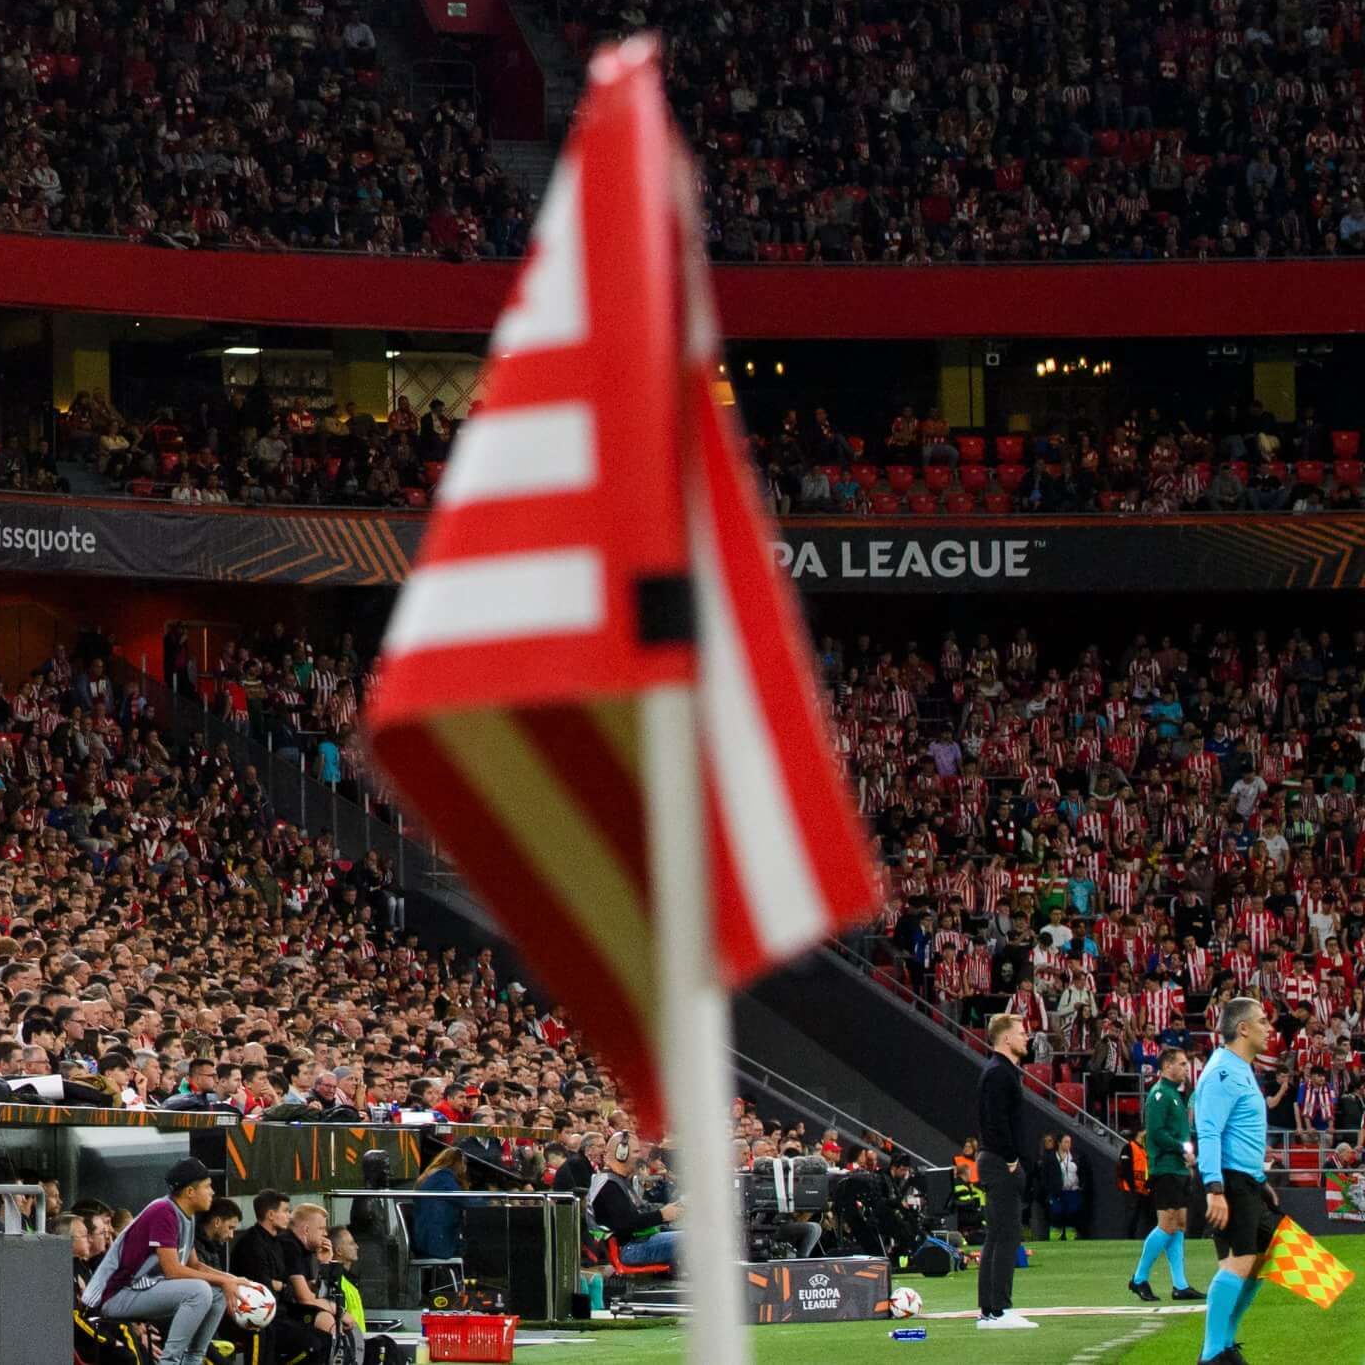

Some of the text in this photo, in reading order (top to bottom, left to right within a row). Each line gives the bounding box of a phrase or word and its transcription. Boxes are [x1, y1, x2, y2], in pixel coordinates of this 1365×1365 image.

[771, 541, 828, 578] PA
[841, 540, 1031, 578] LEAGUE
[798, 1287, 841, 1301] EUROPA
[802, 1298, 838, 1311] LEAGUE
